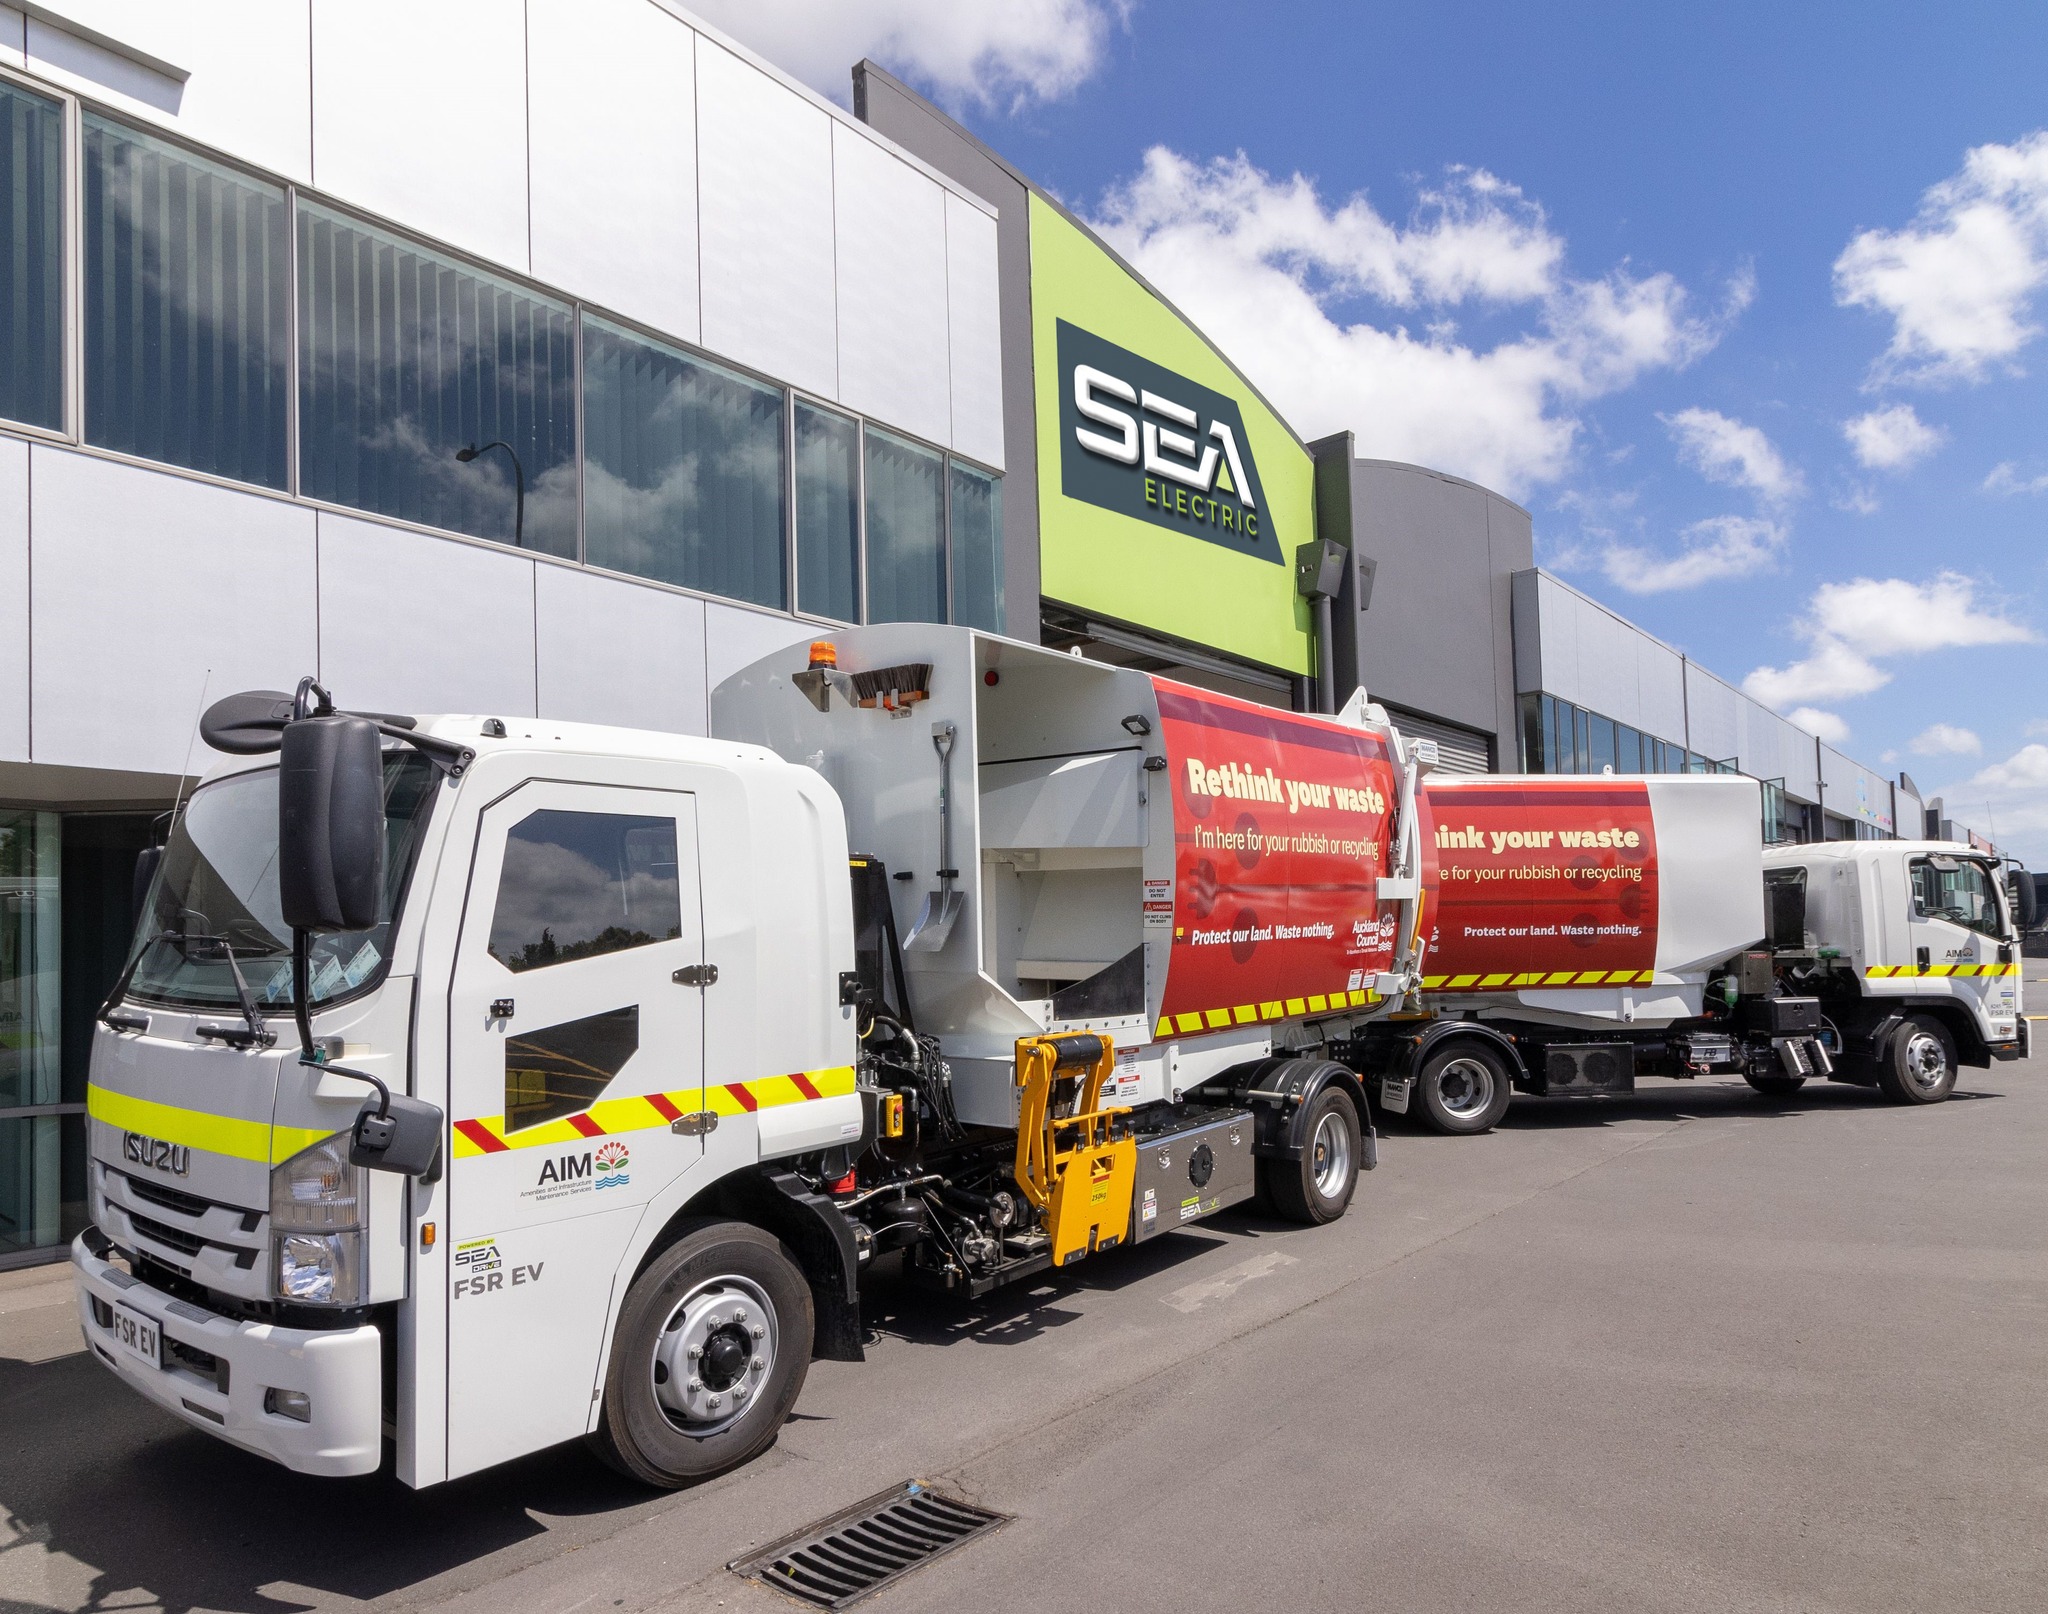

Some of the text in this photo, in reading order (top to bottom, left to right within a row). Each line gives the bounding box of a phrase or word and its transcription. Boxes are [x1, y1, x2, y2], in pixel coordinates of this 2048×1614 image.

[1074, 364, 1256, 509] SEA
[1144, 477, 1259, 536] ELECTRIC
[1186, 757, 1385, 815] Rethink your waste
[1194, 824, 1379, 861] I'm here for your rubbish or recycling
[1489, 830, 1554, 855] your
[1558, 827, 1640, 848] waste
[1452, 865, 1471, 880] for
[1474, 868, 1506, 883] your
[1509, 865, 1560, 880] rubbish
[1563, 868, 1578, 879] or
[1581, 865, 1642, 882] recycling
[1191, 921, 1335, 946] Protect our land. Waste nothing.
[1352, 919, 1380, 934] Auckland
[1464, 924, 1642, 937] Protect our land. Waste nothing.
[1356, 932, 1379, 947] Council
[1945, 949, 1963, 958] AIM
[123, 1129, 190, 1178] ISUZU
[538, 1152, 592, 1186] AIM
[520, 1179, 592, 1198] Amenities and Infrastructure
[535, 1186, 592, 1201] Maintenance Services
[1180, 1203, 1202, 1220] SEA
[455, 1246, 501, 1266] SEA
[458, 1241, 485, 1250] POWERED
[454, 1261, 545, 1300] FSR EV
[114, 1311, 156, 1358] FSR EV
